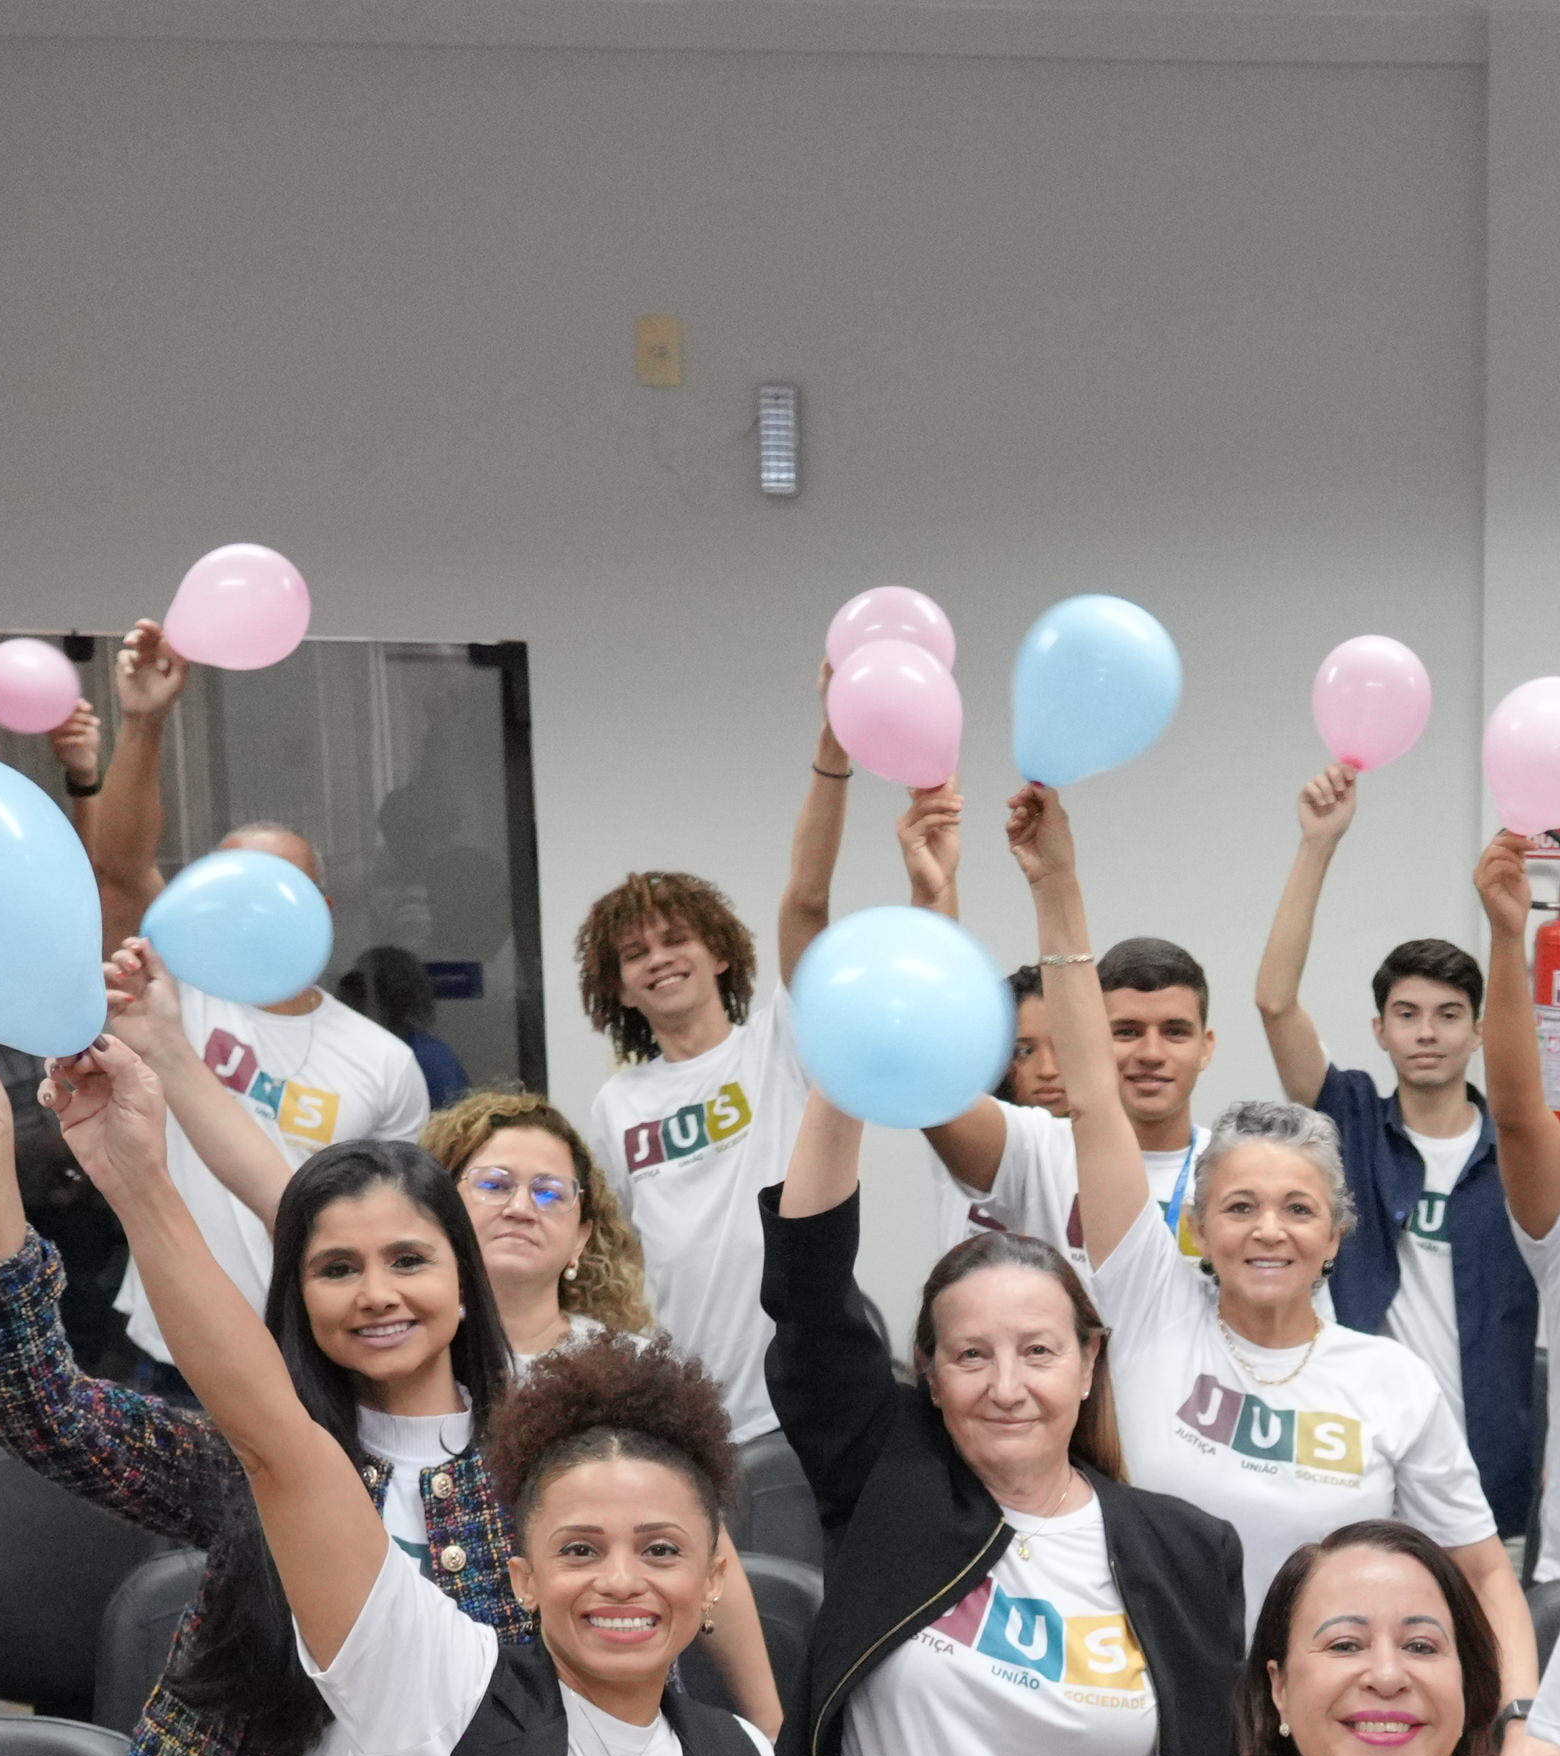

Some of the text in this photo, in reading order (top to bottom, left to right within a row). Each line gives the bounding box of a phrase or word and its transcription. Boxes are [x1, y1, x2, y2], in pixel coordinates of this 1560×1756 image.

[633, 1094, 741, 1163] JUS
[1175, 1427, 1361, 1490] JUSTIÇA UNIÃO SOCIEDADE
[1195, 1386, 1348, 1462] JUS
[1001, 1604, 1129, 1675] US
[991, 1664, 1041, 1691] UNIÃO
